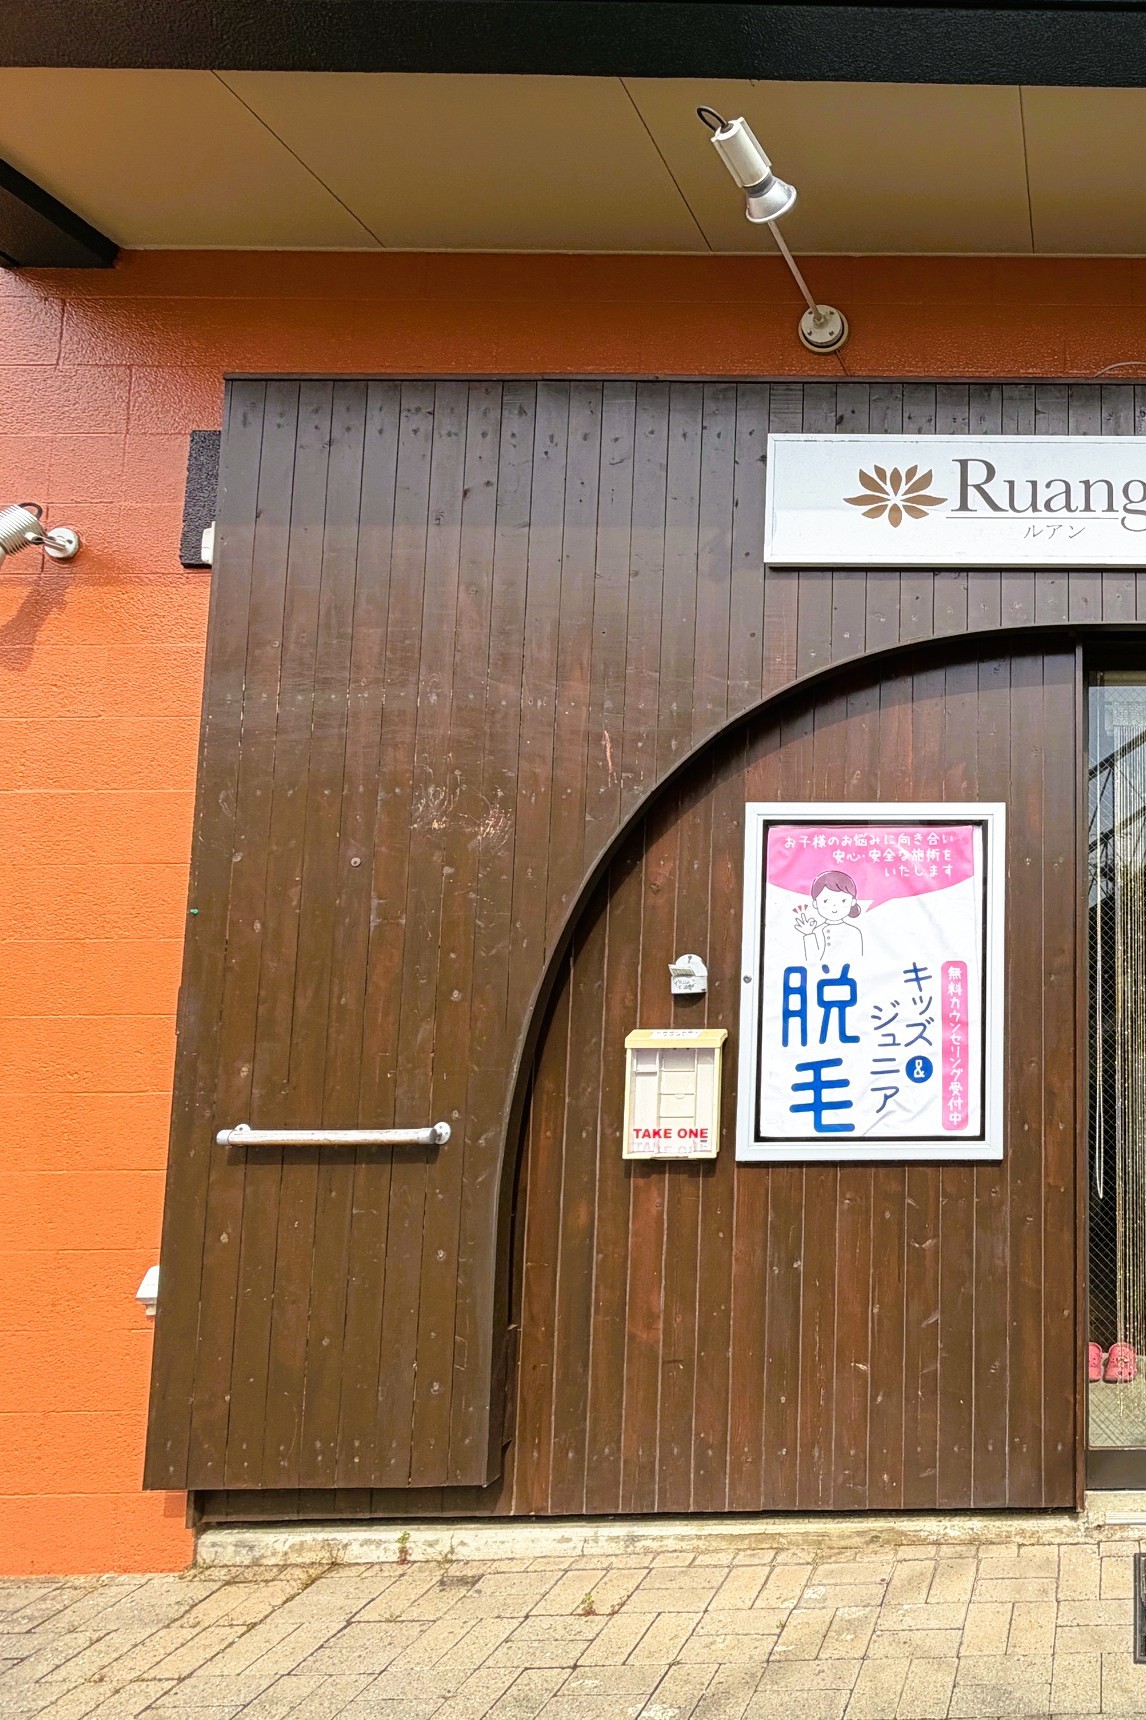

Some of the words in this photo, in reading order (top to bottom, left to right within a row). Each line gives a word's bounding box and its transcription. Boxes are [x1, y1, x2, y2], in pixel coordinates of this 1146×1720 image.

[1023, 522, 1086, 540] ルアン
[784, 832, 956, 848] お子様のお悩みに向き合い
[884, 863, 954, 878] いたします
[782, 963, 860, 1133] 脱毛
[947, 966, 964, 1126] 無料カウンセリング受付中
[870, 1000, 901, 1113] ジュニア
[633, 1129, 672, 1139] TAKE
[677, 1128, 709, 1139] ONE
